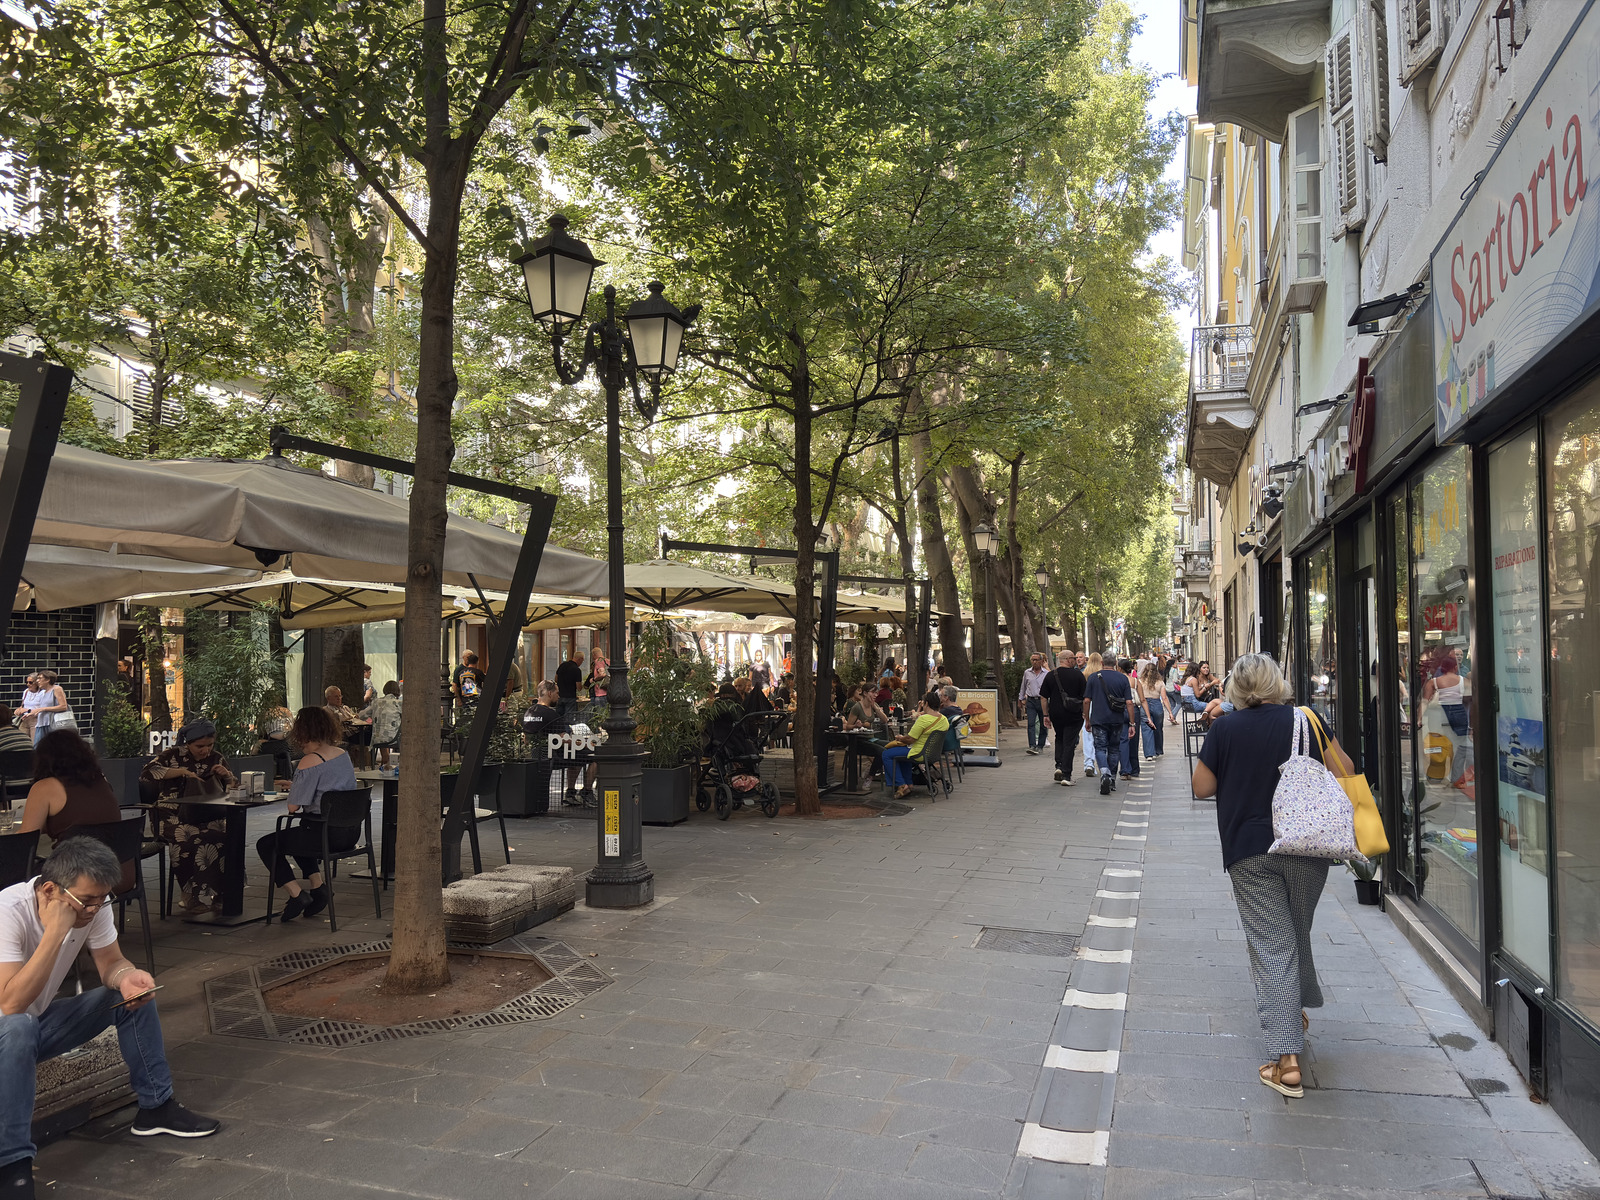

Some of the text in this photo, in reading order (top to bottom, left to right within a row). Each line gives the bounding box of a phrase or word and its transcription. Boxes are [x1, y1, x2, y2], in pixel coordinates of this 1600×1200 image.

[1451, 106, 1588, 344] Sartoria
[1495, 545, 1536, 570] RIPARAZIONE
[1424, 602, 1458, 632] SALDI
